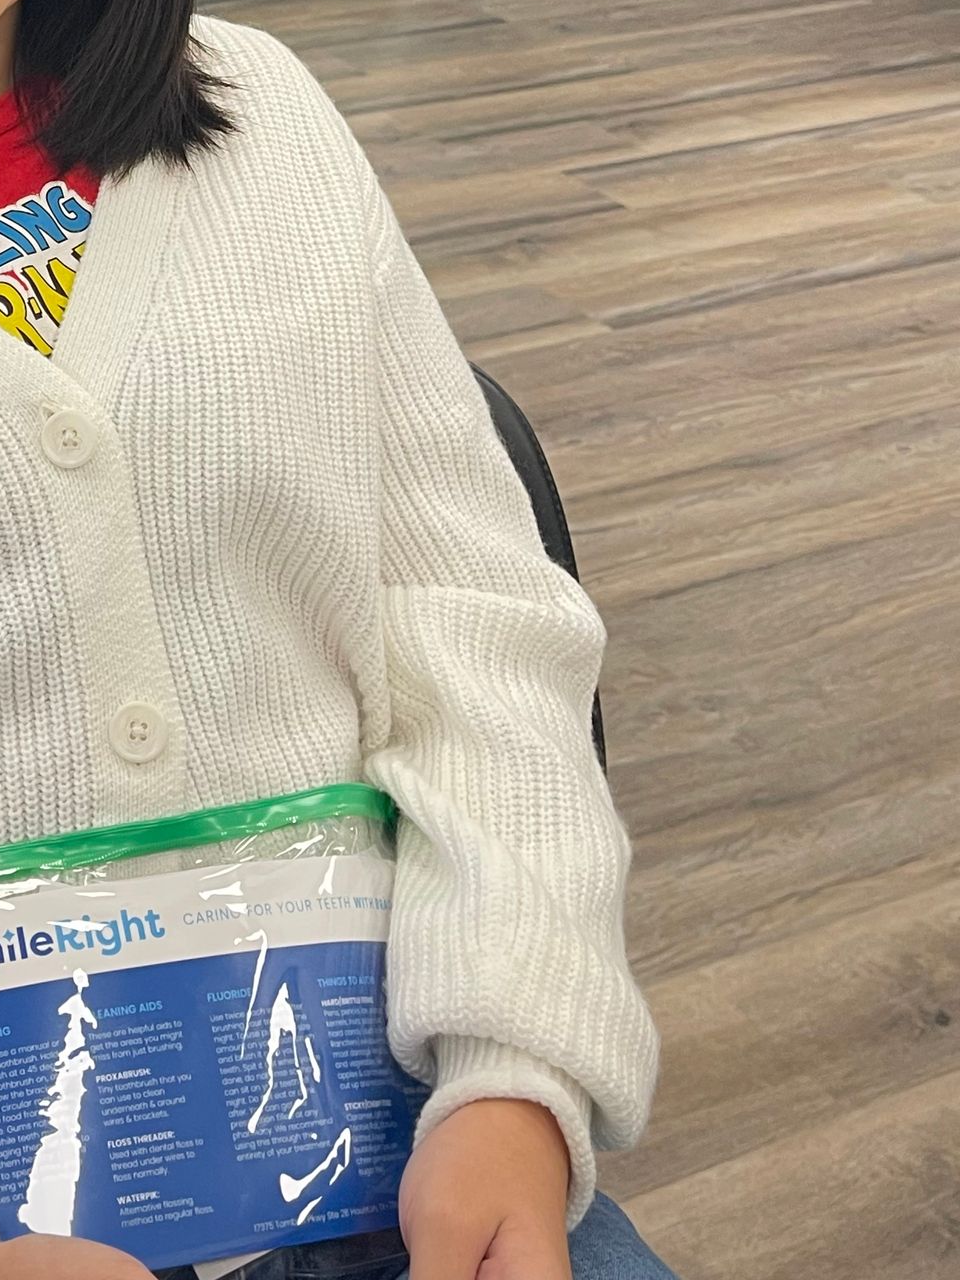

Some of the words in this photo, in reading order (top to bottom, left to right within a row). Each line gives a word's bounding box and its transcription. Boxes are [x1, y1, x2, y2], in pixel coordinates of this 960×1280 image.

[183, 903, 240, 926] CARING
[246, 903, 273, 917] FOR
[276, 899, 312, 913] YOUR
[316, 896, 350, 910] TEETH
[353, 897, 374, 909] WITH
[317, 976, 347, 988] THINGS
[348, 976, 357, 984] TO
[97, 1004, 136, 1019] EANING
[139, 1000, 163, 1012] AIDS
[173, 1020, 182, 1028] to
[18, 1040, 49, 1053] manual
[105, 1041, 118, 1049] the
[144, 1035, 158, 1045] you
[216, 1044, 244, 1053] amoun
[9, 1069, 18, 1078] at
[19, 1068, 25, 1076] a
[177, 1073, 192, 1084] you
[11, 1088, 24, 1098] the
[100, 1096, 115, 1105] can
[133, 1091, 142, 1099] to
[107, 1137, 132, 1149] FLOSS
[1, 1171, 9, 1180] to
